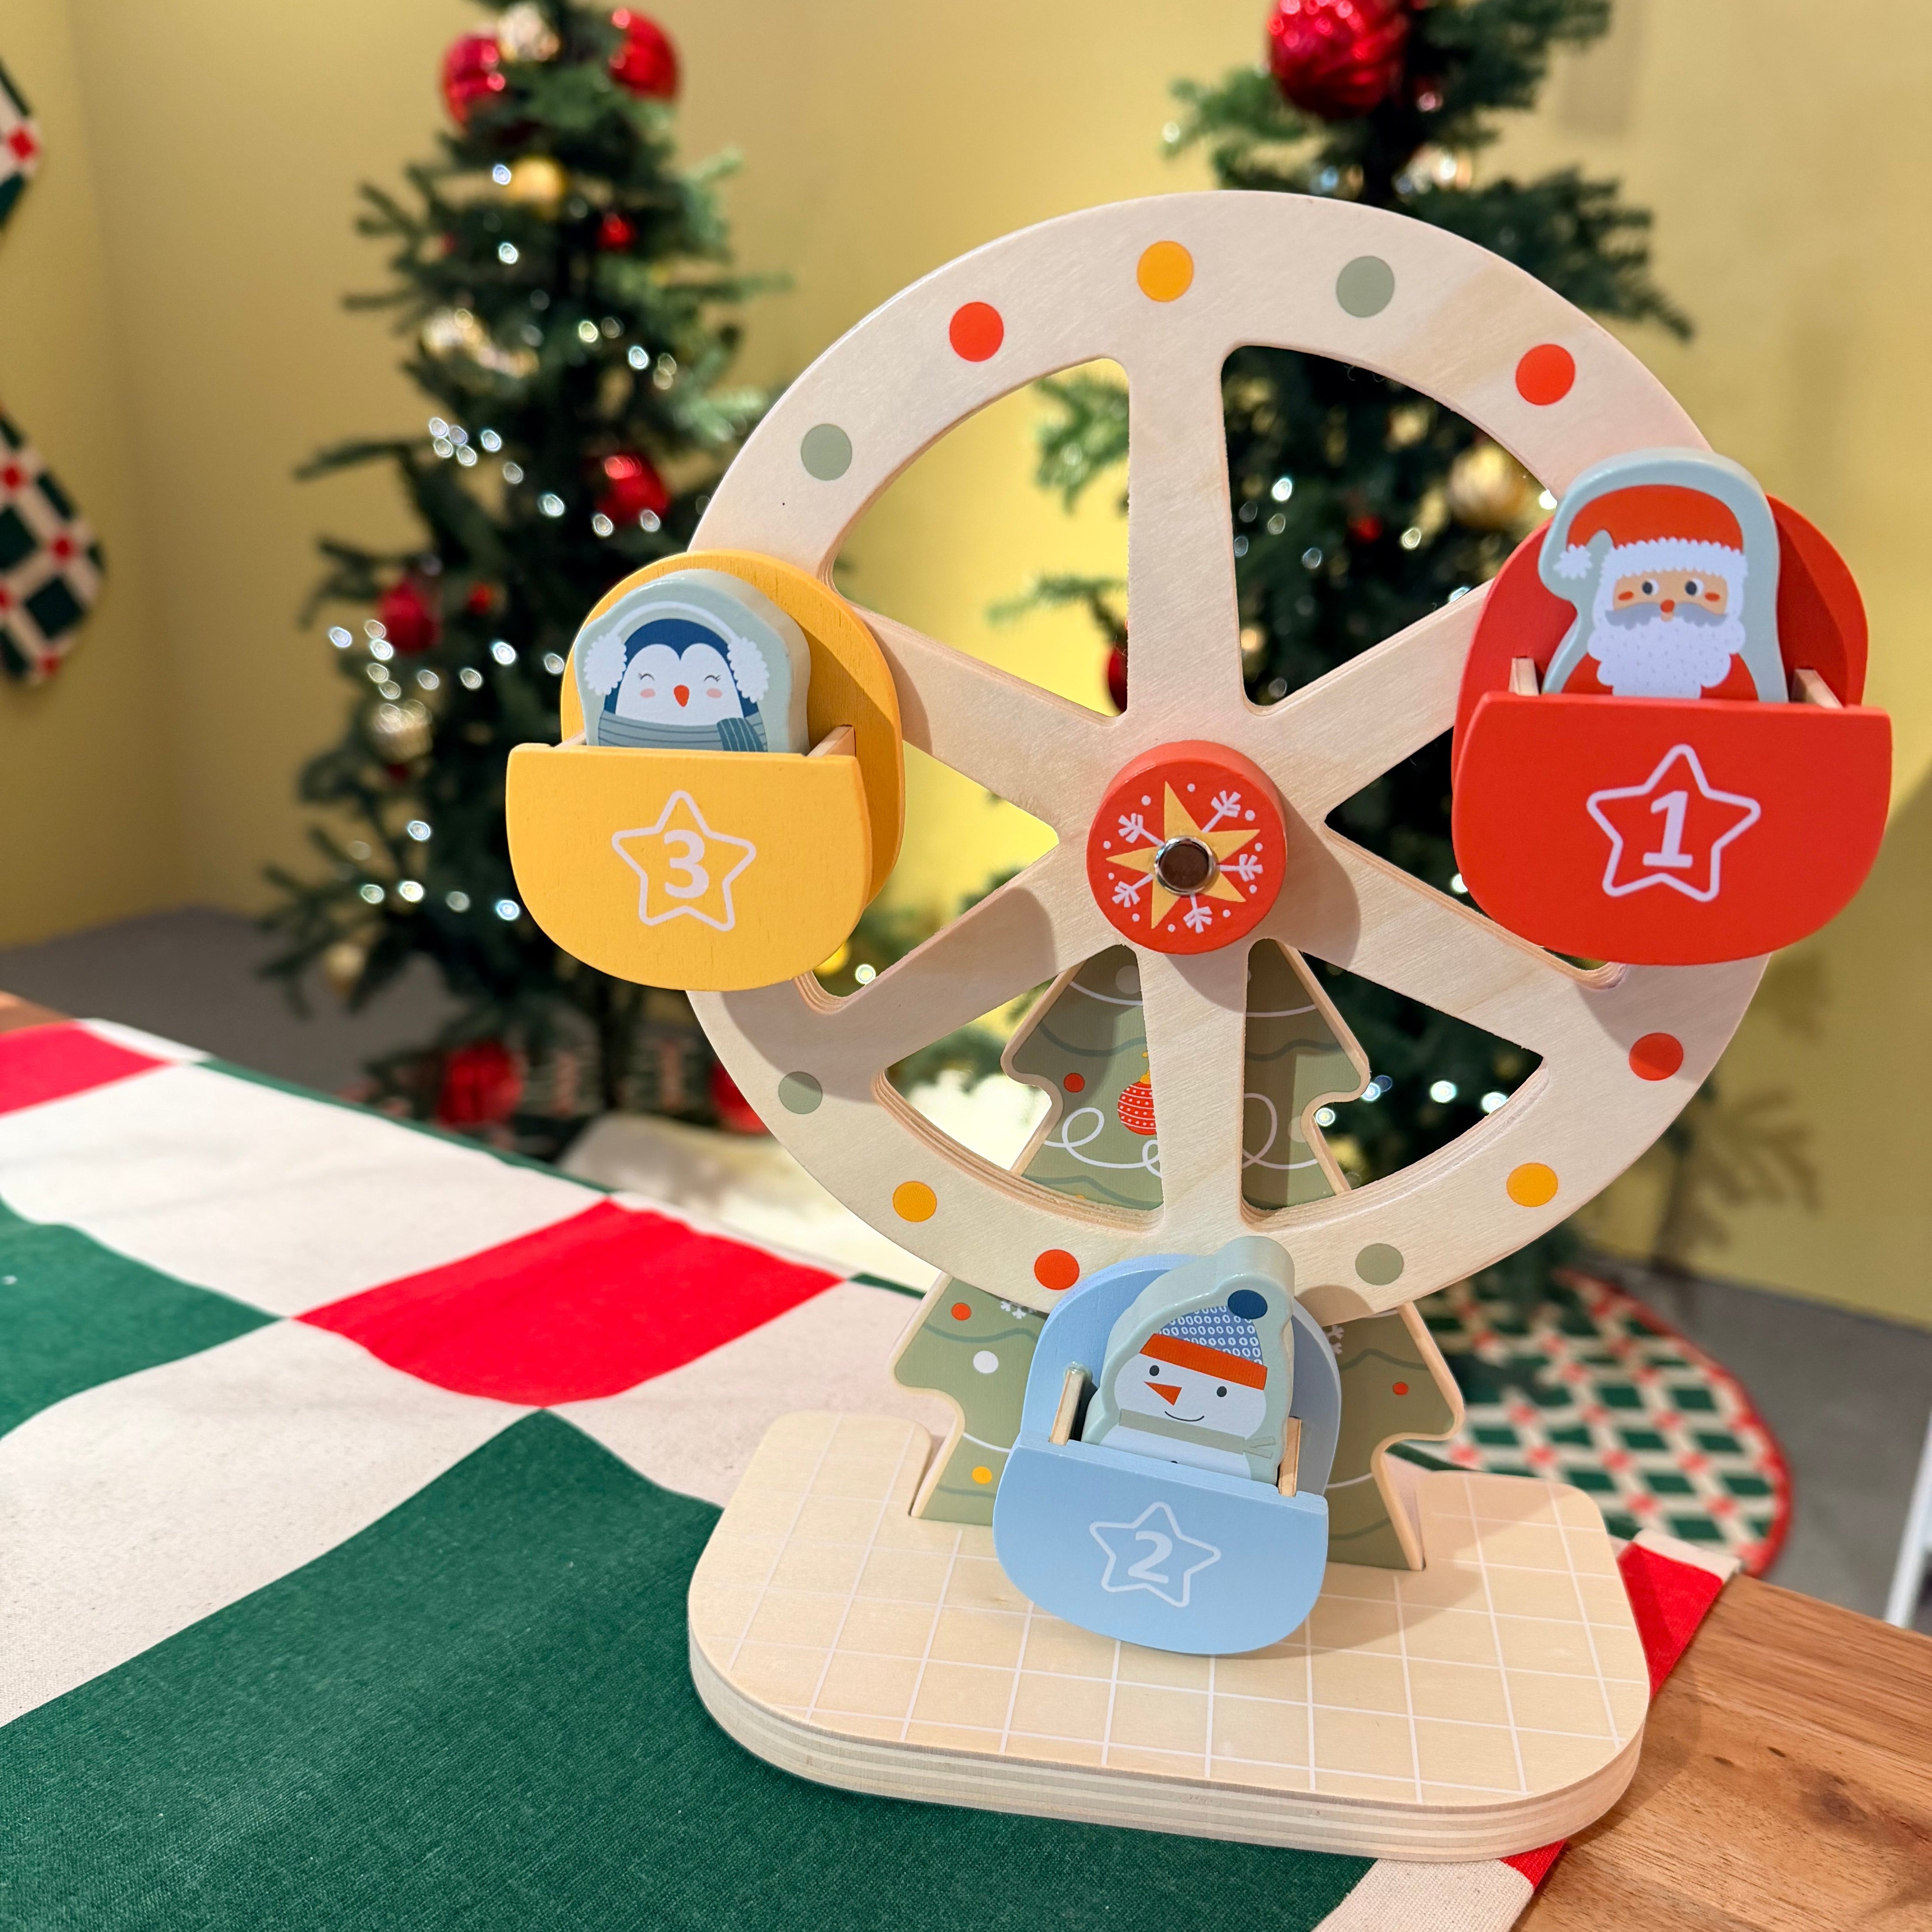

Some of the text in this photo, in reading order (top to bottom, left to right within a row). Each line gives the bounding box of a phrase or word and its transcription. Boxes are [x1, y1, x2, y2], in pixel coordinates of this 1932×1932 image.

[664, 829, 709, 899] 3
[1642, 791, 1693, 868] 1
[1127, 1531, 1173, 1584] 2
